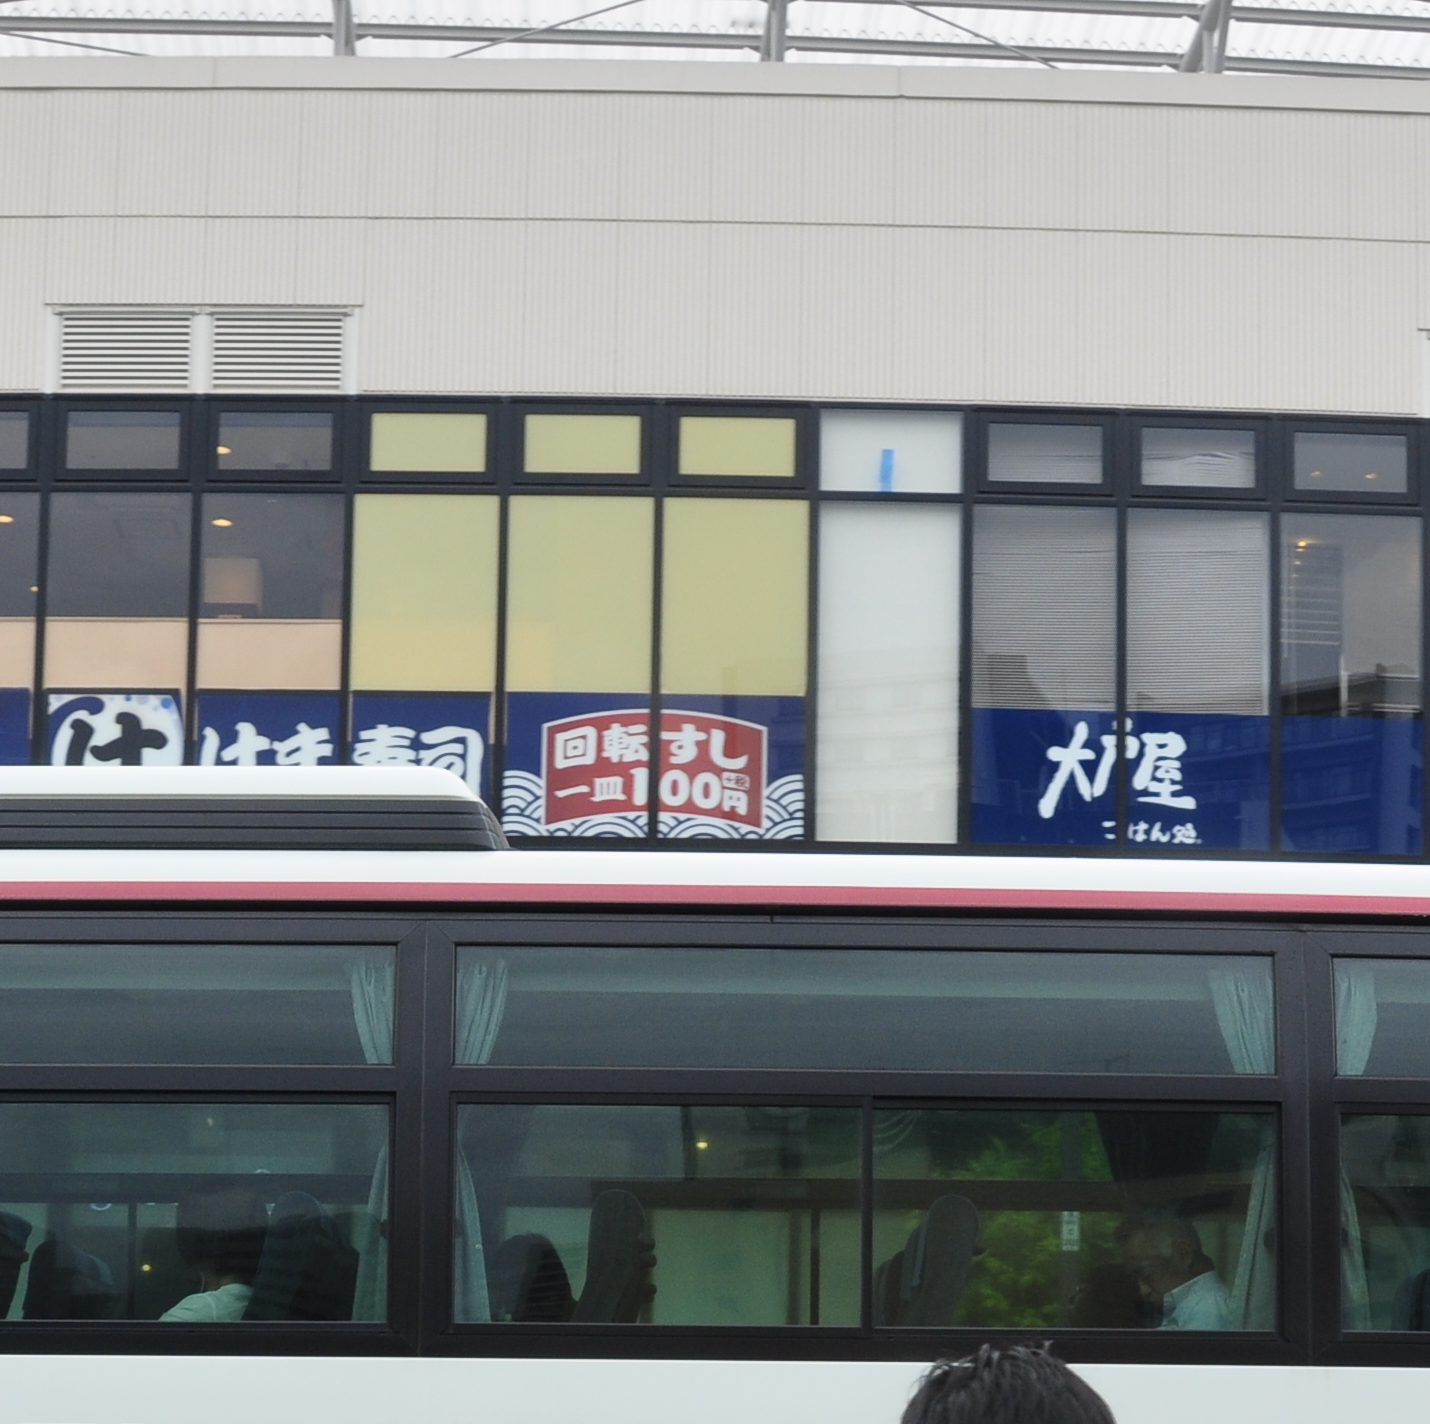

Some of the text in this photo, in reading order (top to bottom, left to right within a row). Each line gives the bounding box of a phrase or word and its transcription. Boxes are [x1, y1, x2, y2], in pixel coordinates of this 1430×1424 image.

[554, 723, 749, 770] 回転すし
[1038, 718, 1197, 819] 大戸屋
